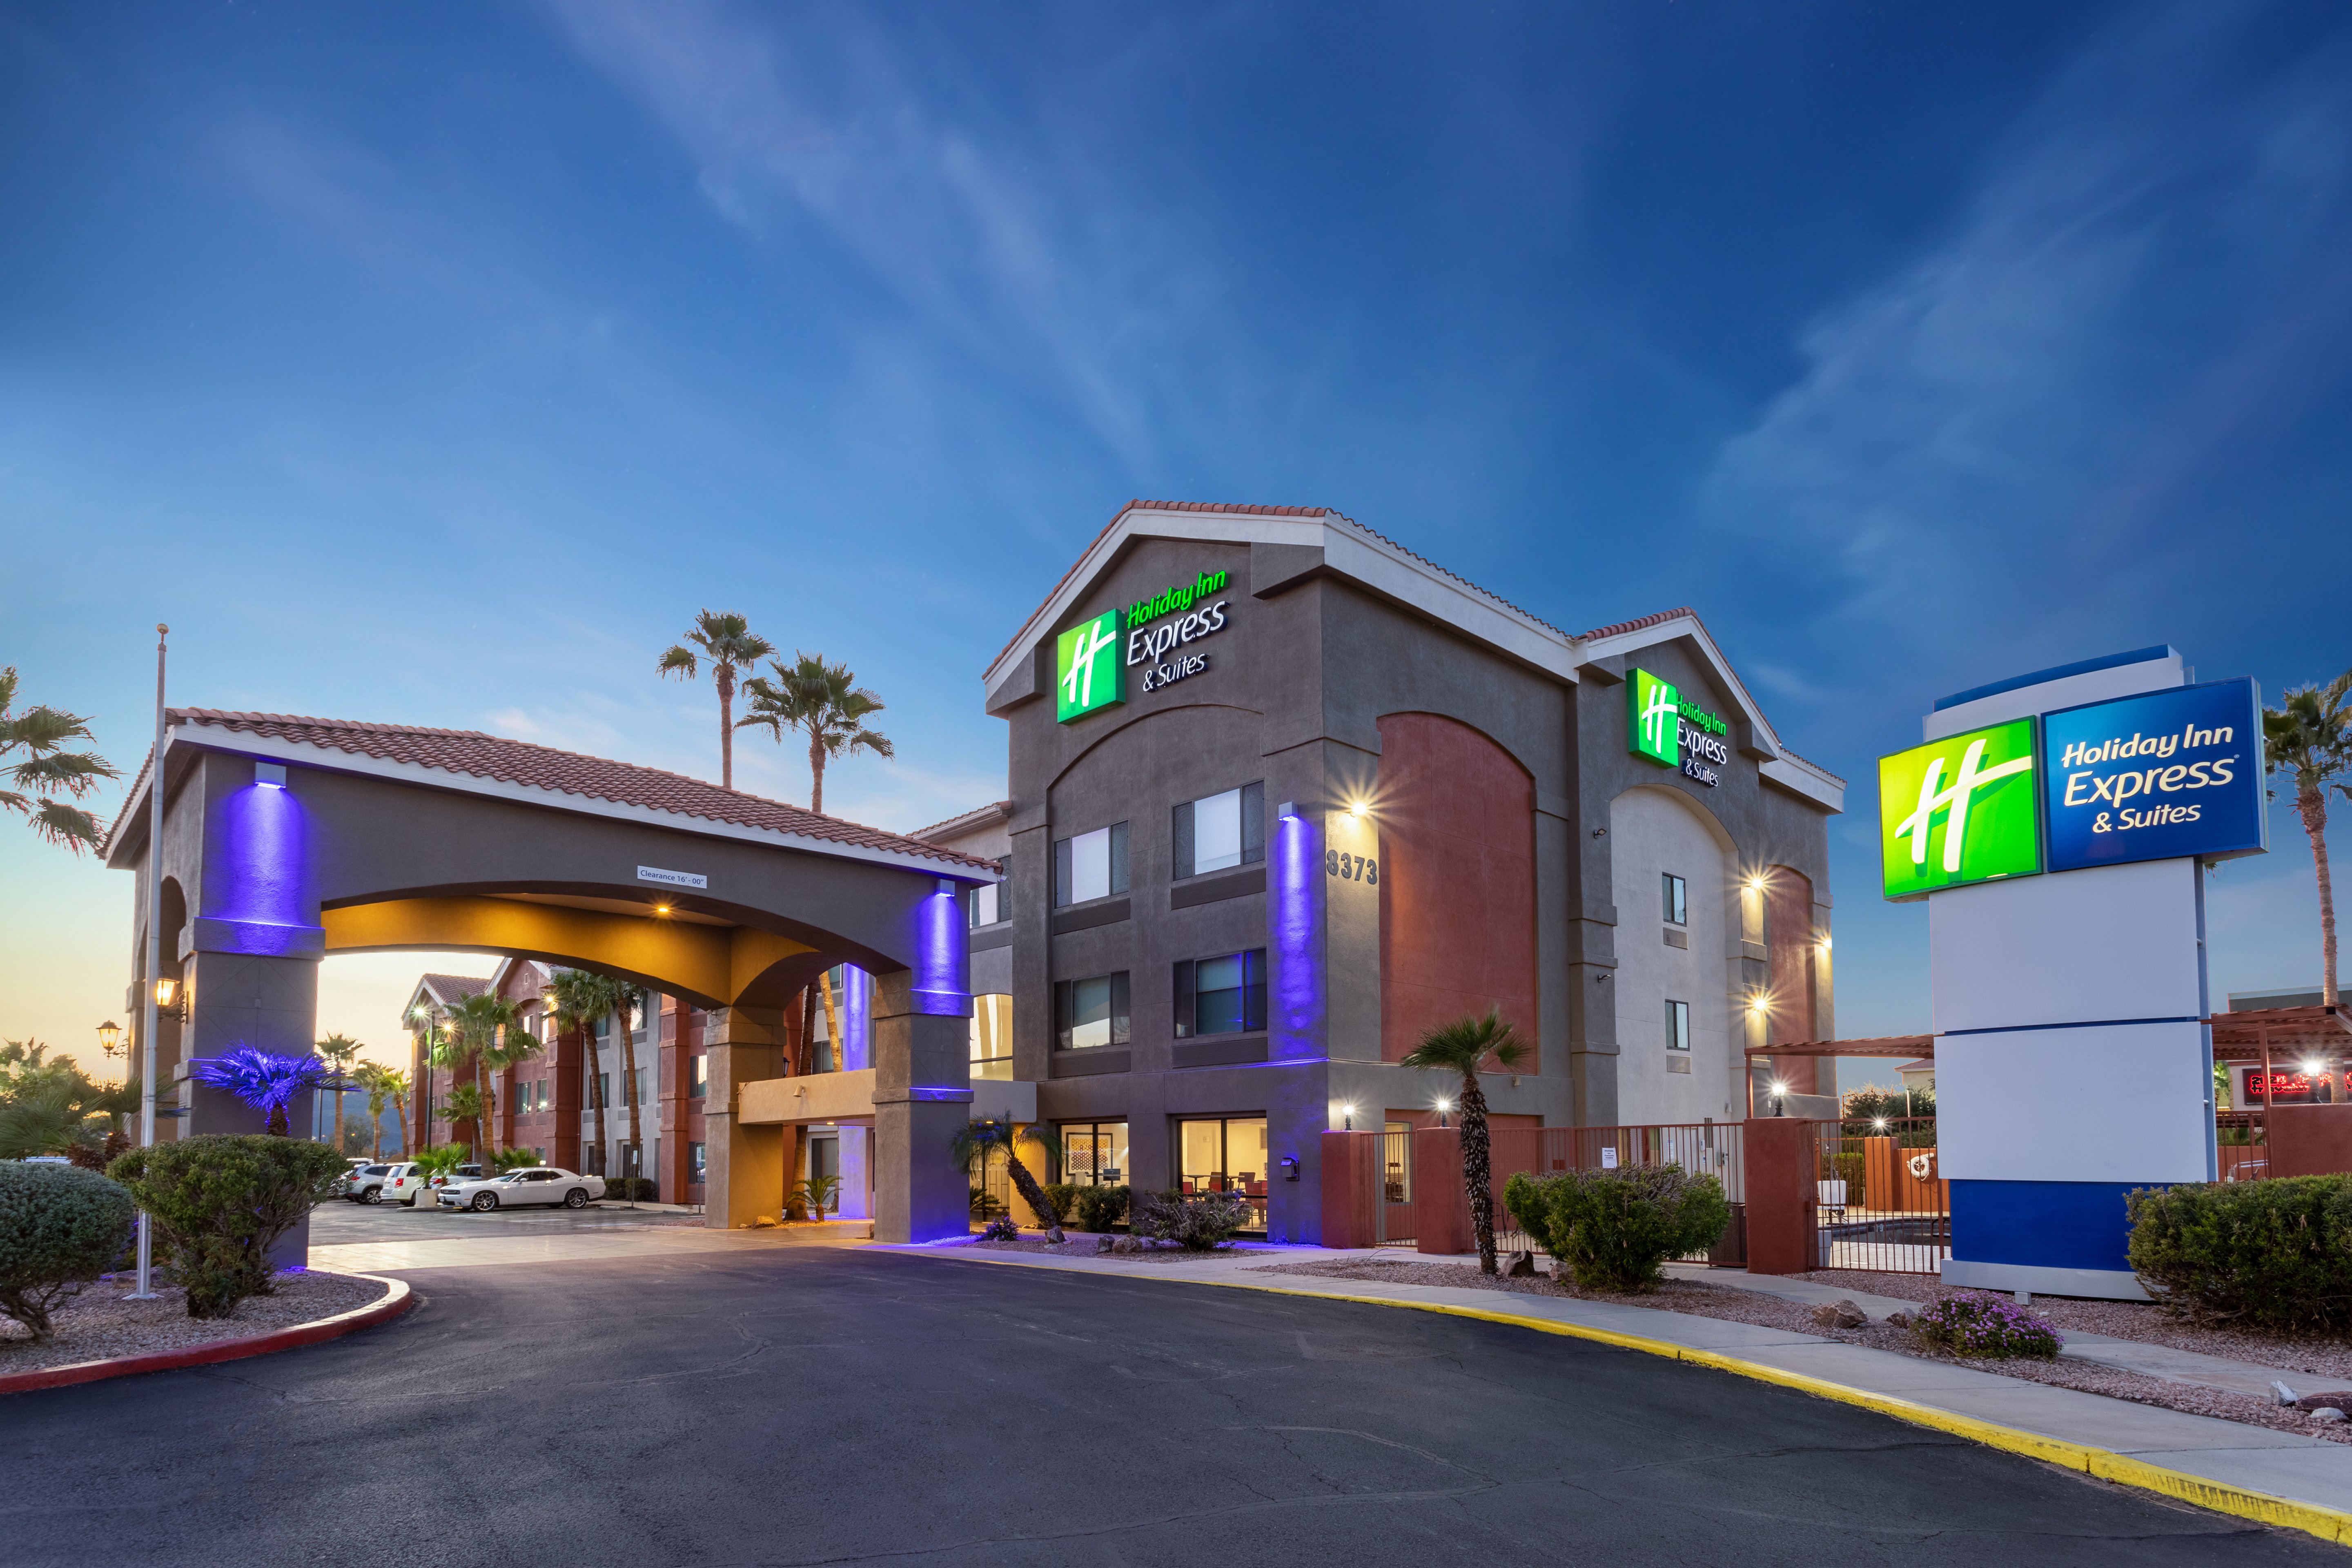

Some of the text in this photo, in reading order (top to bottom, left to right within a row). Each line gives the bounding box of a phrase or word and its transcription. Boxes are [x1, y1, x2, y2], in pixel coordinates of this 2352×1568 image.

[1127, 570, 1227, 630] Holiday Inn
[1127, 601, 1226, 666] Express
[1143, 653, 1205, 693] & Suites
[1677, 693, 1726, 736] Holiday Inn
[1677, 717, 1727, 765] Express
[2061, 724, 2233, 768] Holiday Inn
[1686, 758, 1718, 787] & Suites
[2064, 758, 2235, 808] Express
[2092, 804, 2201, 833] & Suites
[640, 870, 675, 881] Clearance
[1327, 849, 1377, 885] 8373
